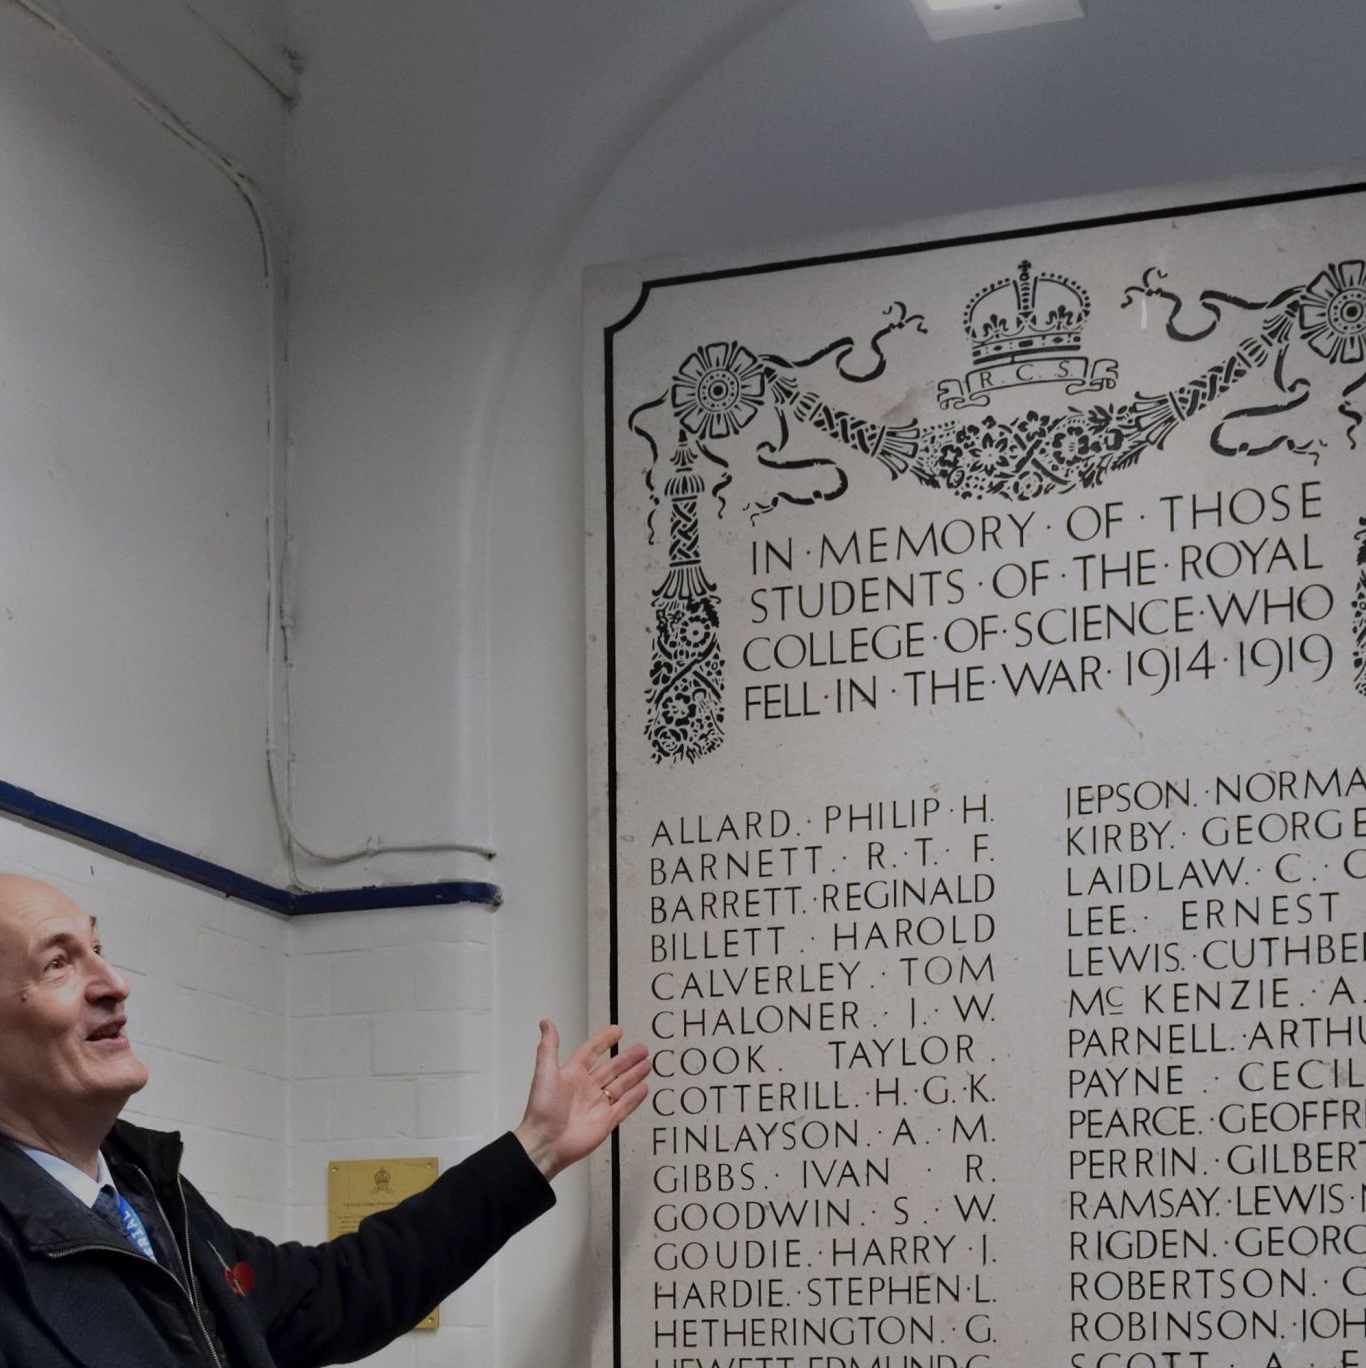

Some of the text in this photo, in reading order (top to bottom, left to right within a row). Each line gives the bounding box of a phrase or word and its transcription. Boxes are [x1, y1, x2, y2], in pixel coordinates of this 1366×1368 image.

[752, 481, 1321, 575] IN MEMORY OF THOSE
[751, 533, 1324, 624] STUDENTS OF THE ROYAL
[743, 584, 1334, 672] COLLEGE OF SCIENCE WHO
[745, 633, 1333, 721] FELL IN THE WAR 1914 1919
[825, 797, 940, 834] PHILIP
[822, 873, 995, 913] REGINALD
[1182, 891, 1340, 931] ERNEST
[834, 913, 995, 951] HAROLD
[899, 953, 995, 986] TOM
[1238, 1058, 1365, 1092] CECIL
[803, 1157, 889, 1189] IVAN
[1236, 1183, 1344, 1216] LEWIS
[832, 1234, 956, 1267] HARRY
[807, 1274, 960, 1307] STEPHEN
